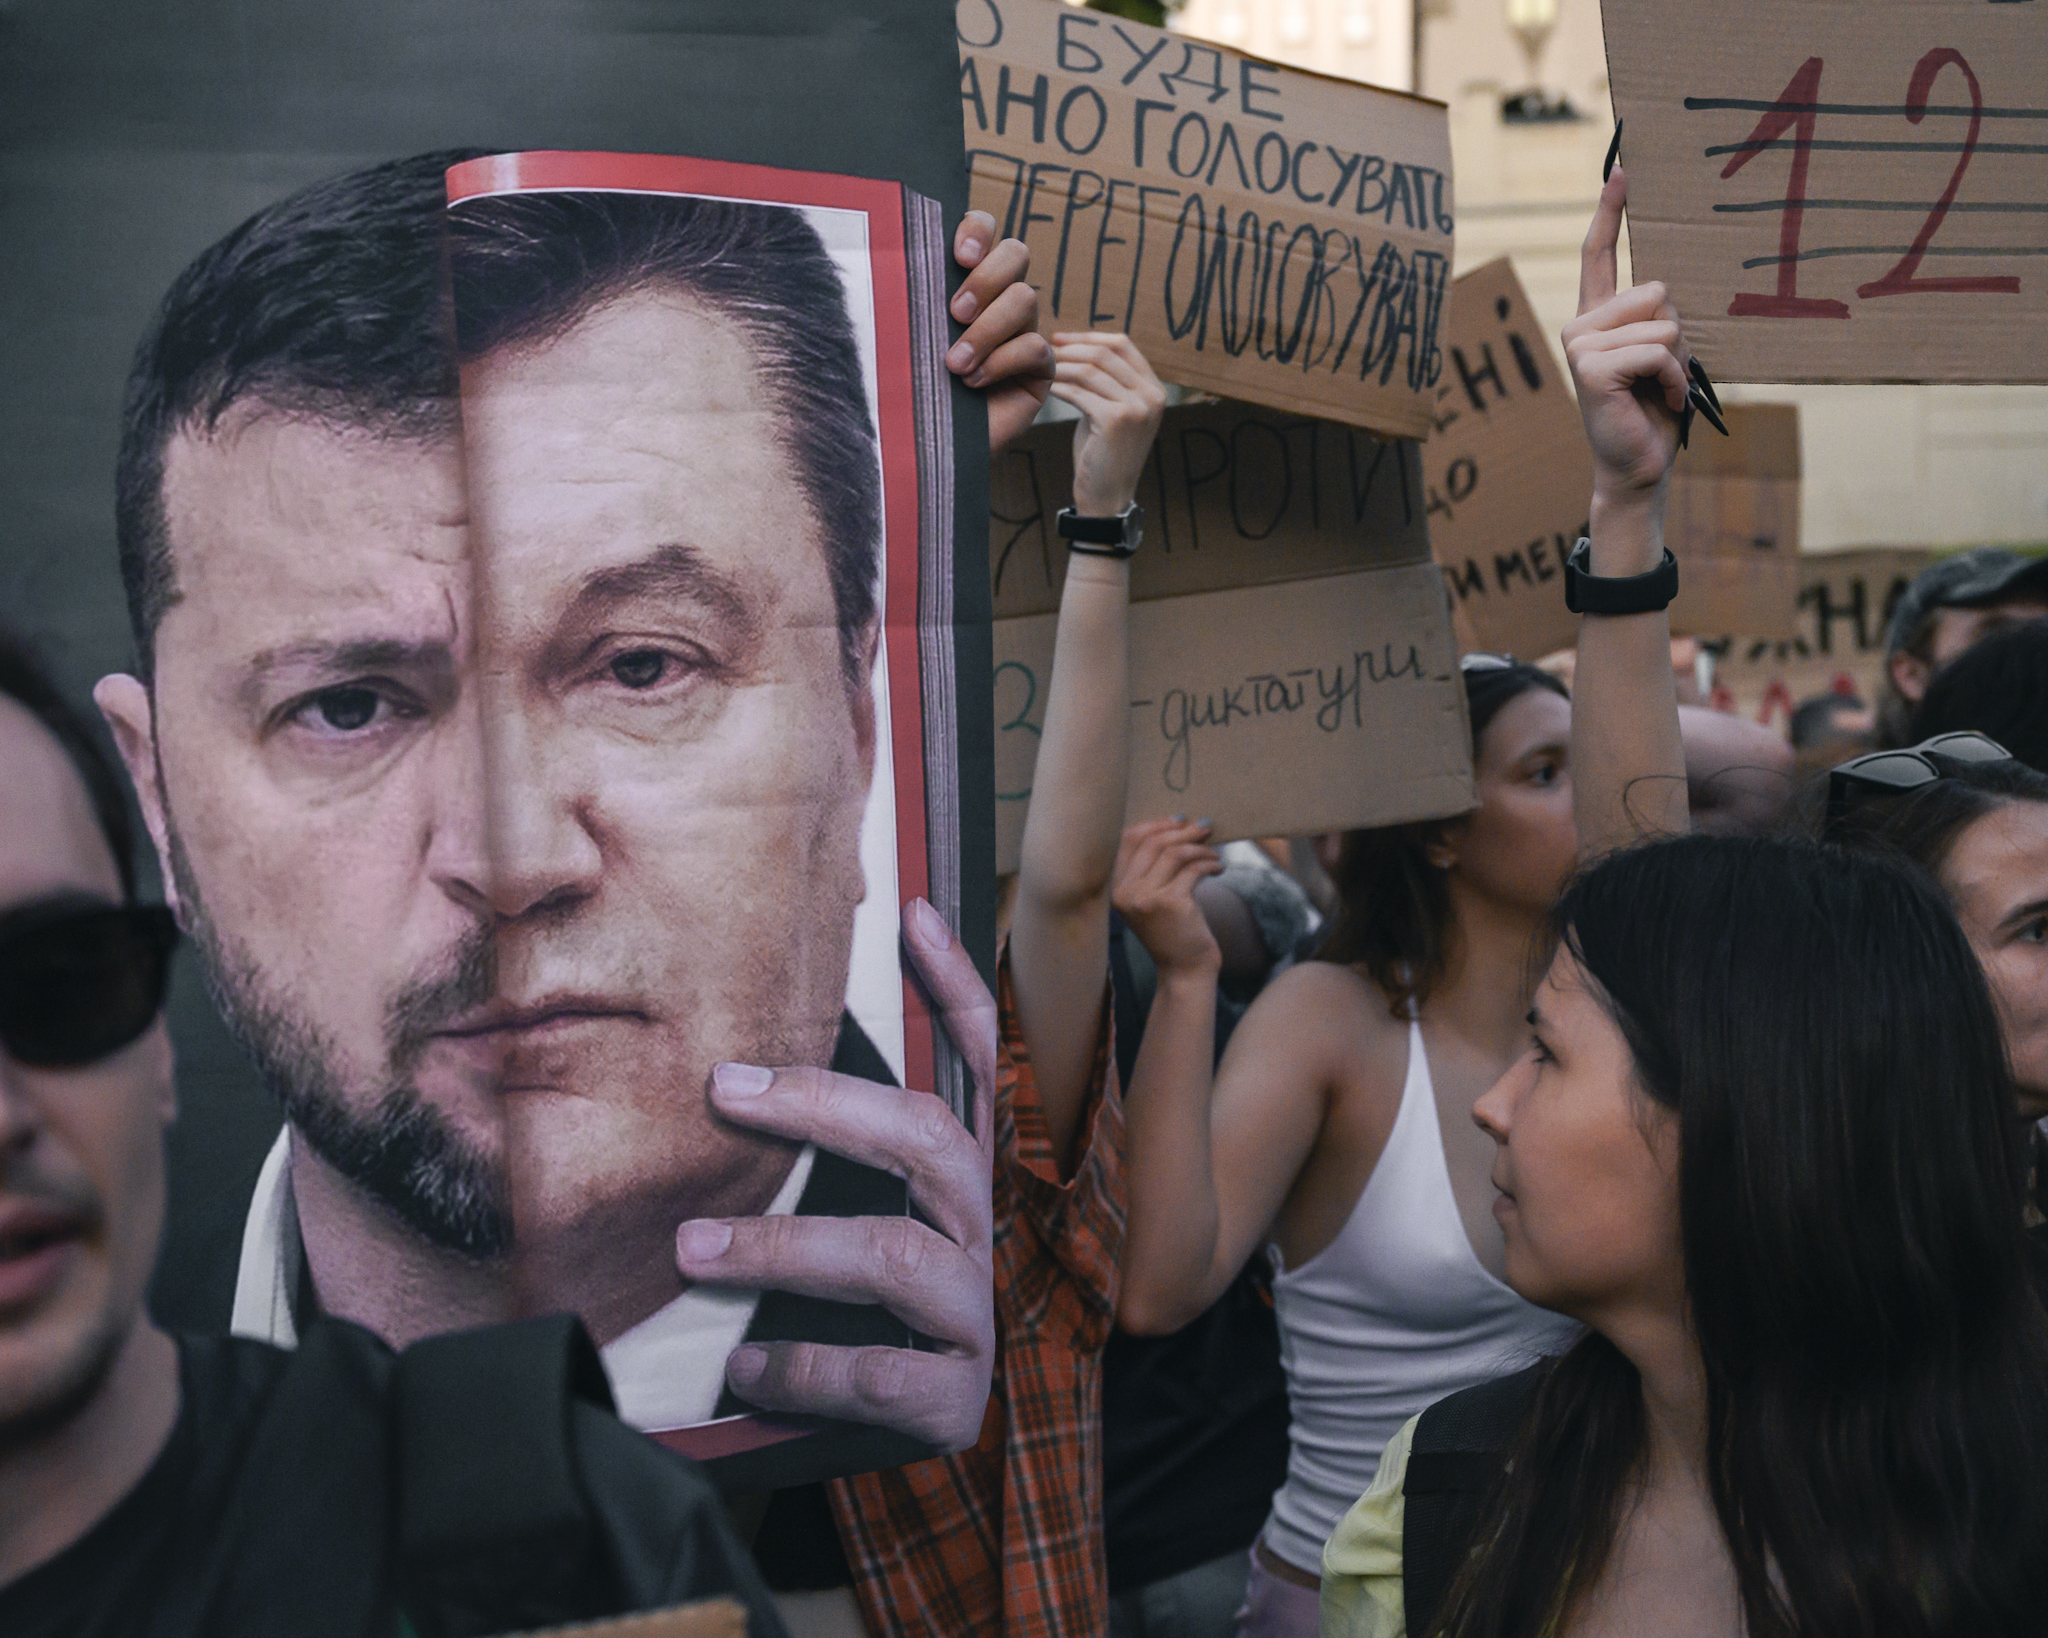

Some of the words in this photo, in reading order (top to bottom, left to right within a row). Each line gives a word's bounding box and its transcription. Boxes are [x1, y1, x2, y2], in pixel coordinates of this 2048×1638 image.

[1057, 13, 1284, 122] БУДЕ
[1134, 98, 1454, 236] ГОЛОСУВАТЬ
[1719, 48, 2022, 319] 12
